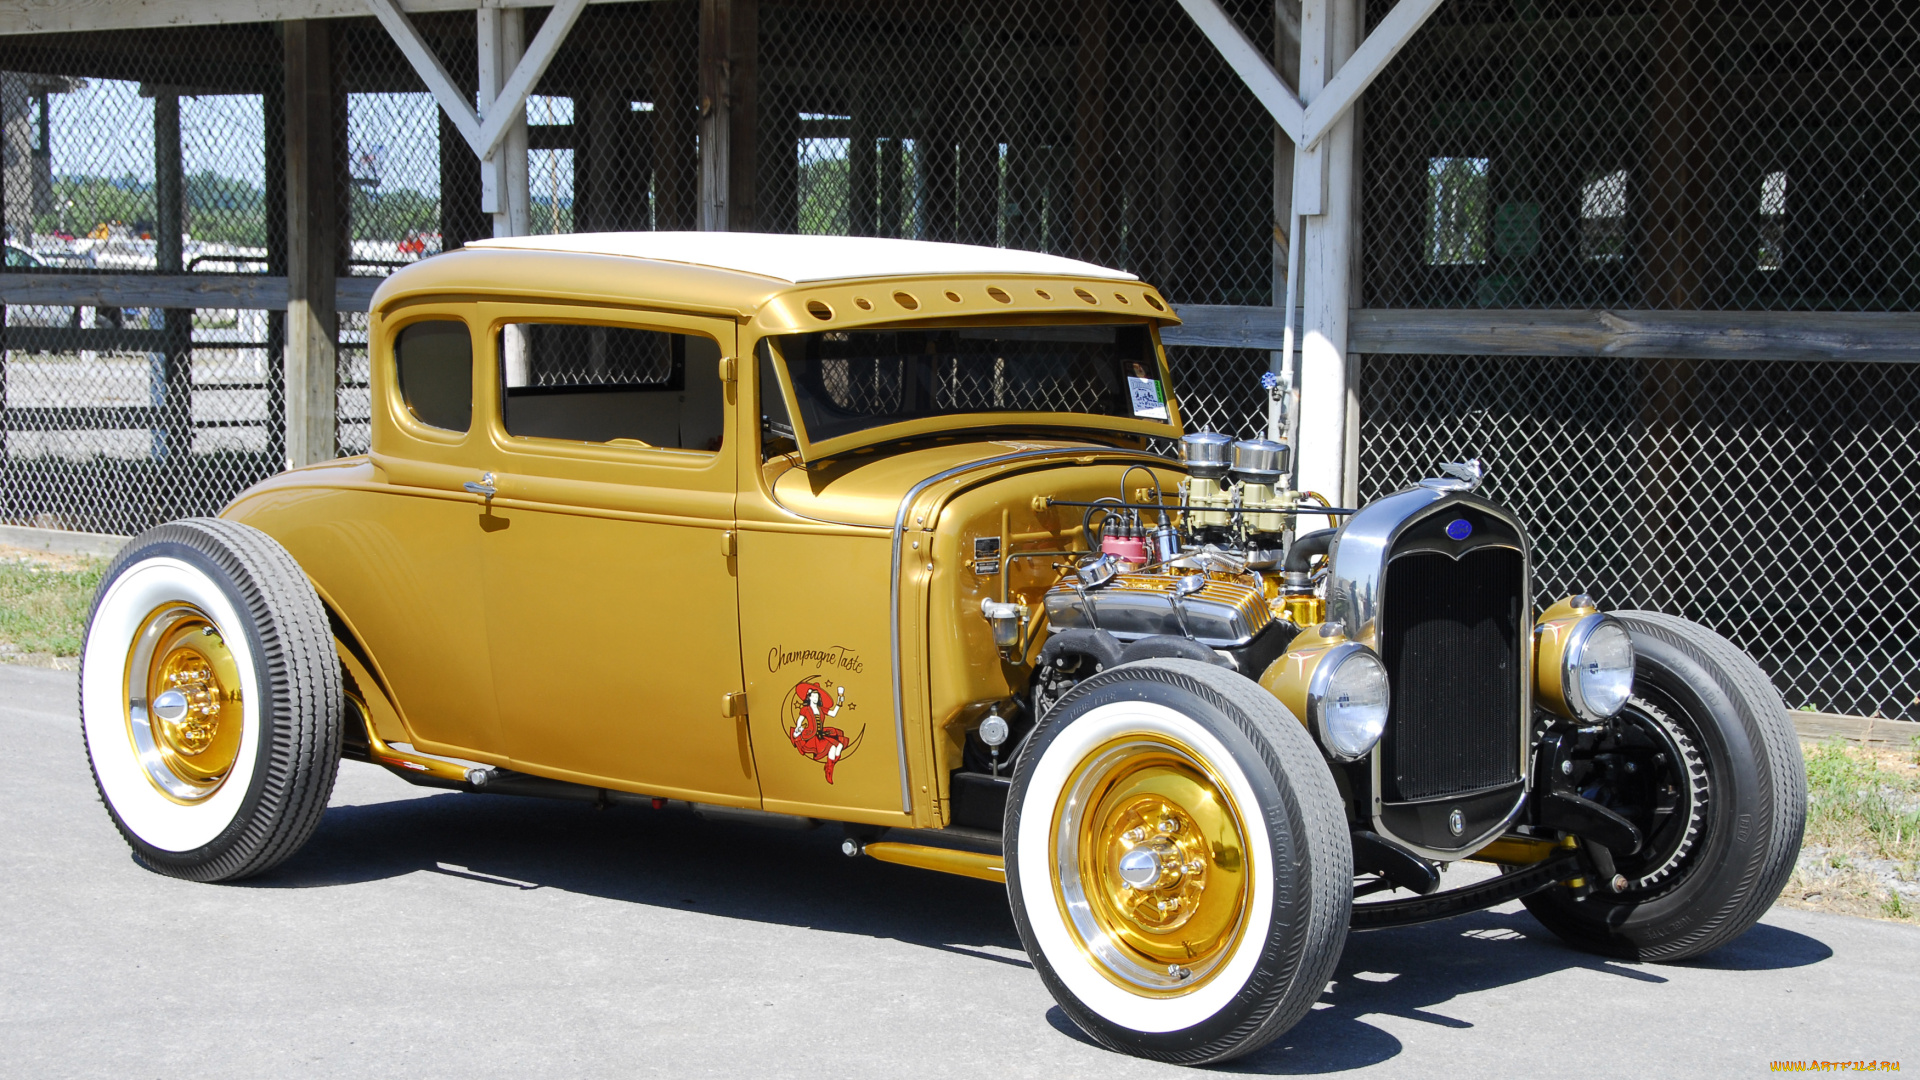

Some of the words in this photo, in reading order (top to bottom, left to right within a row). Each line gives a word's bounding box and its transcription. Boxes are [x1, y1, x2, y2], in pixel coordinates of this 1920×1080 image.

[768, 644, 836, 674] Champagne
[830, 645, 864, 674] Taste
[1706, 691, 1721, 707] PLY
[1668, 915, 1694, 932] TUBE
[1265, 920, 1291, 961] Long
